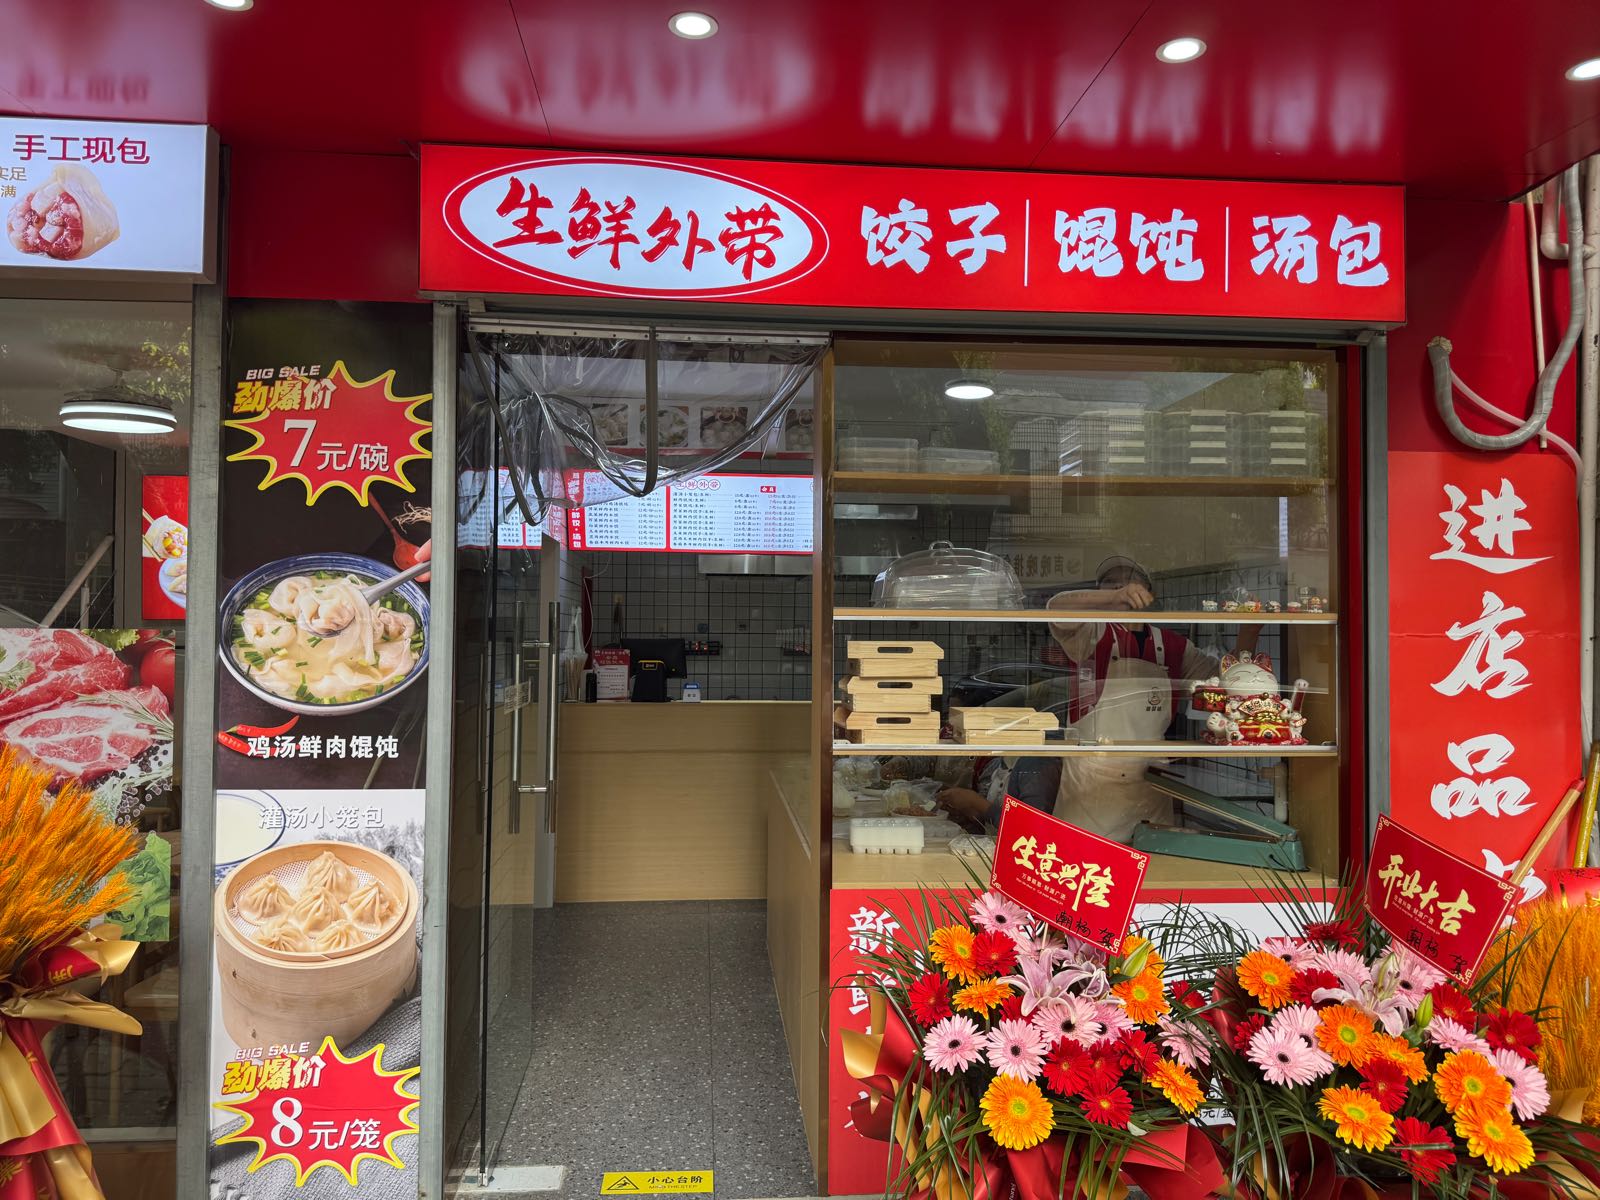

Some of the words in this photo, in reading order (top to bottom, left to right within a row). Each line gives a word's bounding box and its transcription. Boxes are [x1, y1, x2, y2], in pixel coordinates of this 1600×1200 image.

[12, 134, 151, 165] 手工现包
[492, 175, 784, 283] 生鲜外带
[860, 198, 1007, 275] 饺子
[1053, 207, 1205, 283] 馄饨
[1250, 214, 1390, 288] 汤包
[246, 367, 274, 380] BIG
[278, 364, 321, 378] SALE
[233, 377, 337, 414] 劲爆价
[247, 735, 400, 759] 鸡汤鲜肉馄饨
[258, 805, 385, 830] 灌汤小笼包
[1378, 854, 1476, 936] 开业大吉
[235, 1047, 264, 1061] BIG
[268, 1041, 311, 1056] SALE
[221, 1055, 327, 1096] 劲爆价
[647, 1175, 704, 1184] 小心台阶
